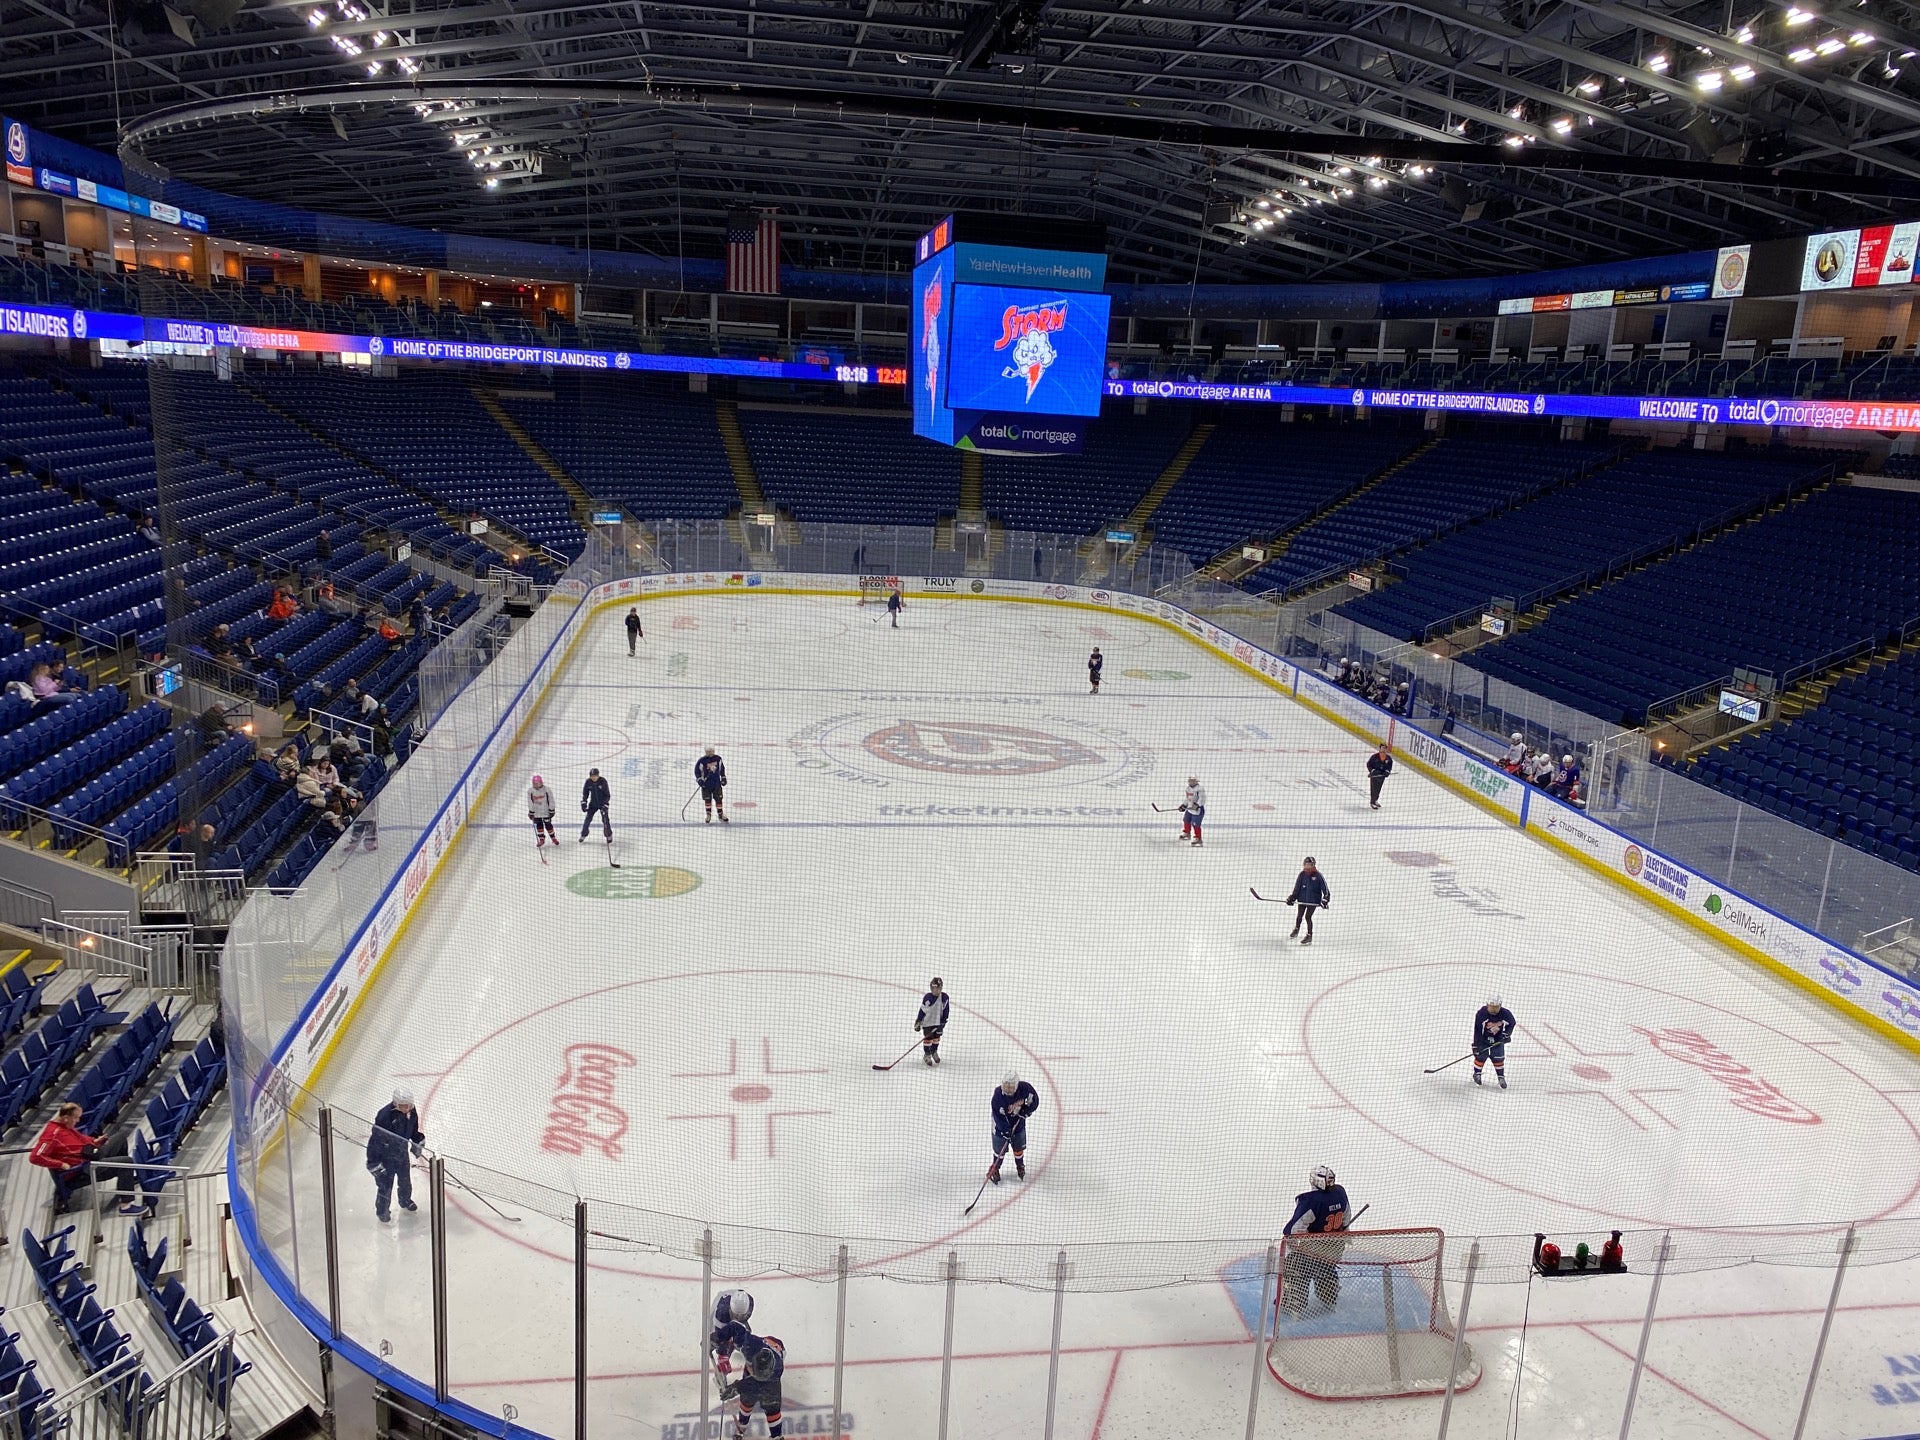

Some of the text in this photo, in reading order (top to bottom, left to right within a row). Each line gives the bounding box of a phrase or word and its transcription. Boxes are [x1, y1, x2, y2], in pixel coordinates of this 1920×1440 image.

[969, 257, 1091, 280] YaleNewHavenHealth
[5, 309, 69, 338] ISLANDERS
[167, 323, 203, 342] WELCOME
[203, 327, 214, 345] TO
[217, 325, 233, 343] total
[264, 333, 299, 347] ARENA
[994, 303, 1069, 351] STORM
[393, 340, 607, 368] HOME OF THE BRIDGEPORT ISLANDERS
[1108, 381, 1272, 400] TO total mortgage ARENA
[1371, 392, 1529, 413] HOME OF THE BRIDGEPORT ISLANDERS
[1639, 400, 1920, 428] WELCOME TO total mortgage ARENA
[981, 425, 1077, 445] total mortgage
[924, 577, 957, 587] TRULY
[1409, 731, 1447, 768] THE BAR
[1464, 760, 1510, 791] PORT JEFF
[1470, 776, 1499, 798] FERRY
[880, 804, 1127, 817] ticketmaster
[1559, 820, 1599, 848] CTLOTTERY.ORG
[1643, 869, 1658, 886] LOCAL
[1658, 875, 1675, 894] UNION
[1645, 854, 1689, 889] ELECTRICIANS
[1723, 903, 1767, 940] CellMark
[1323, 1211, 1344, 1232] 30
[661, 1421, 721, 1440] OVER
